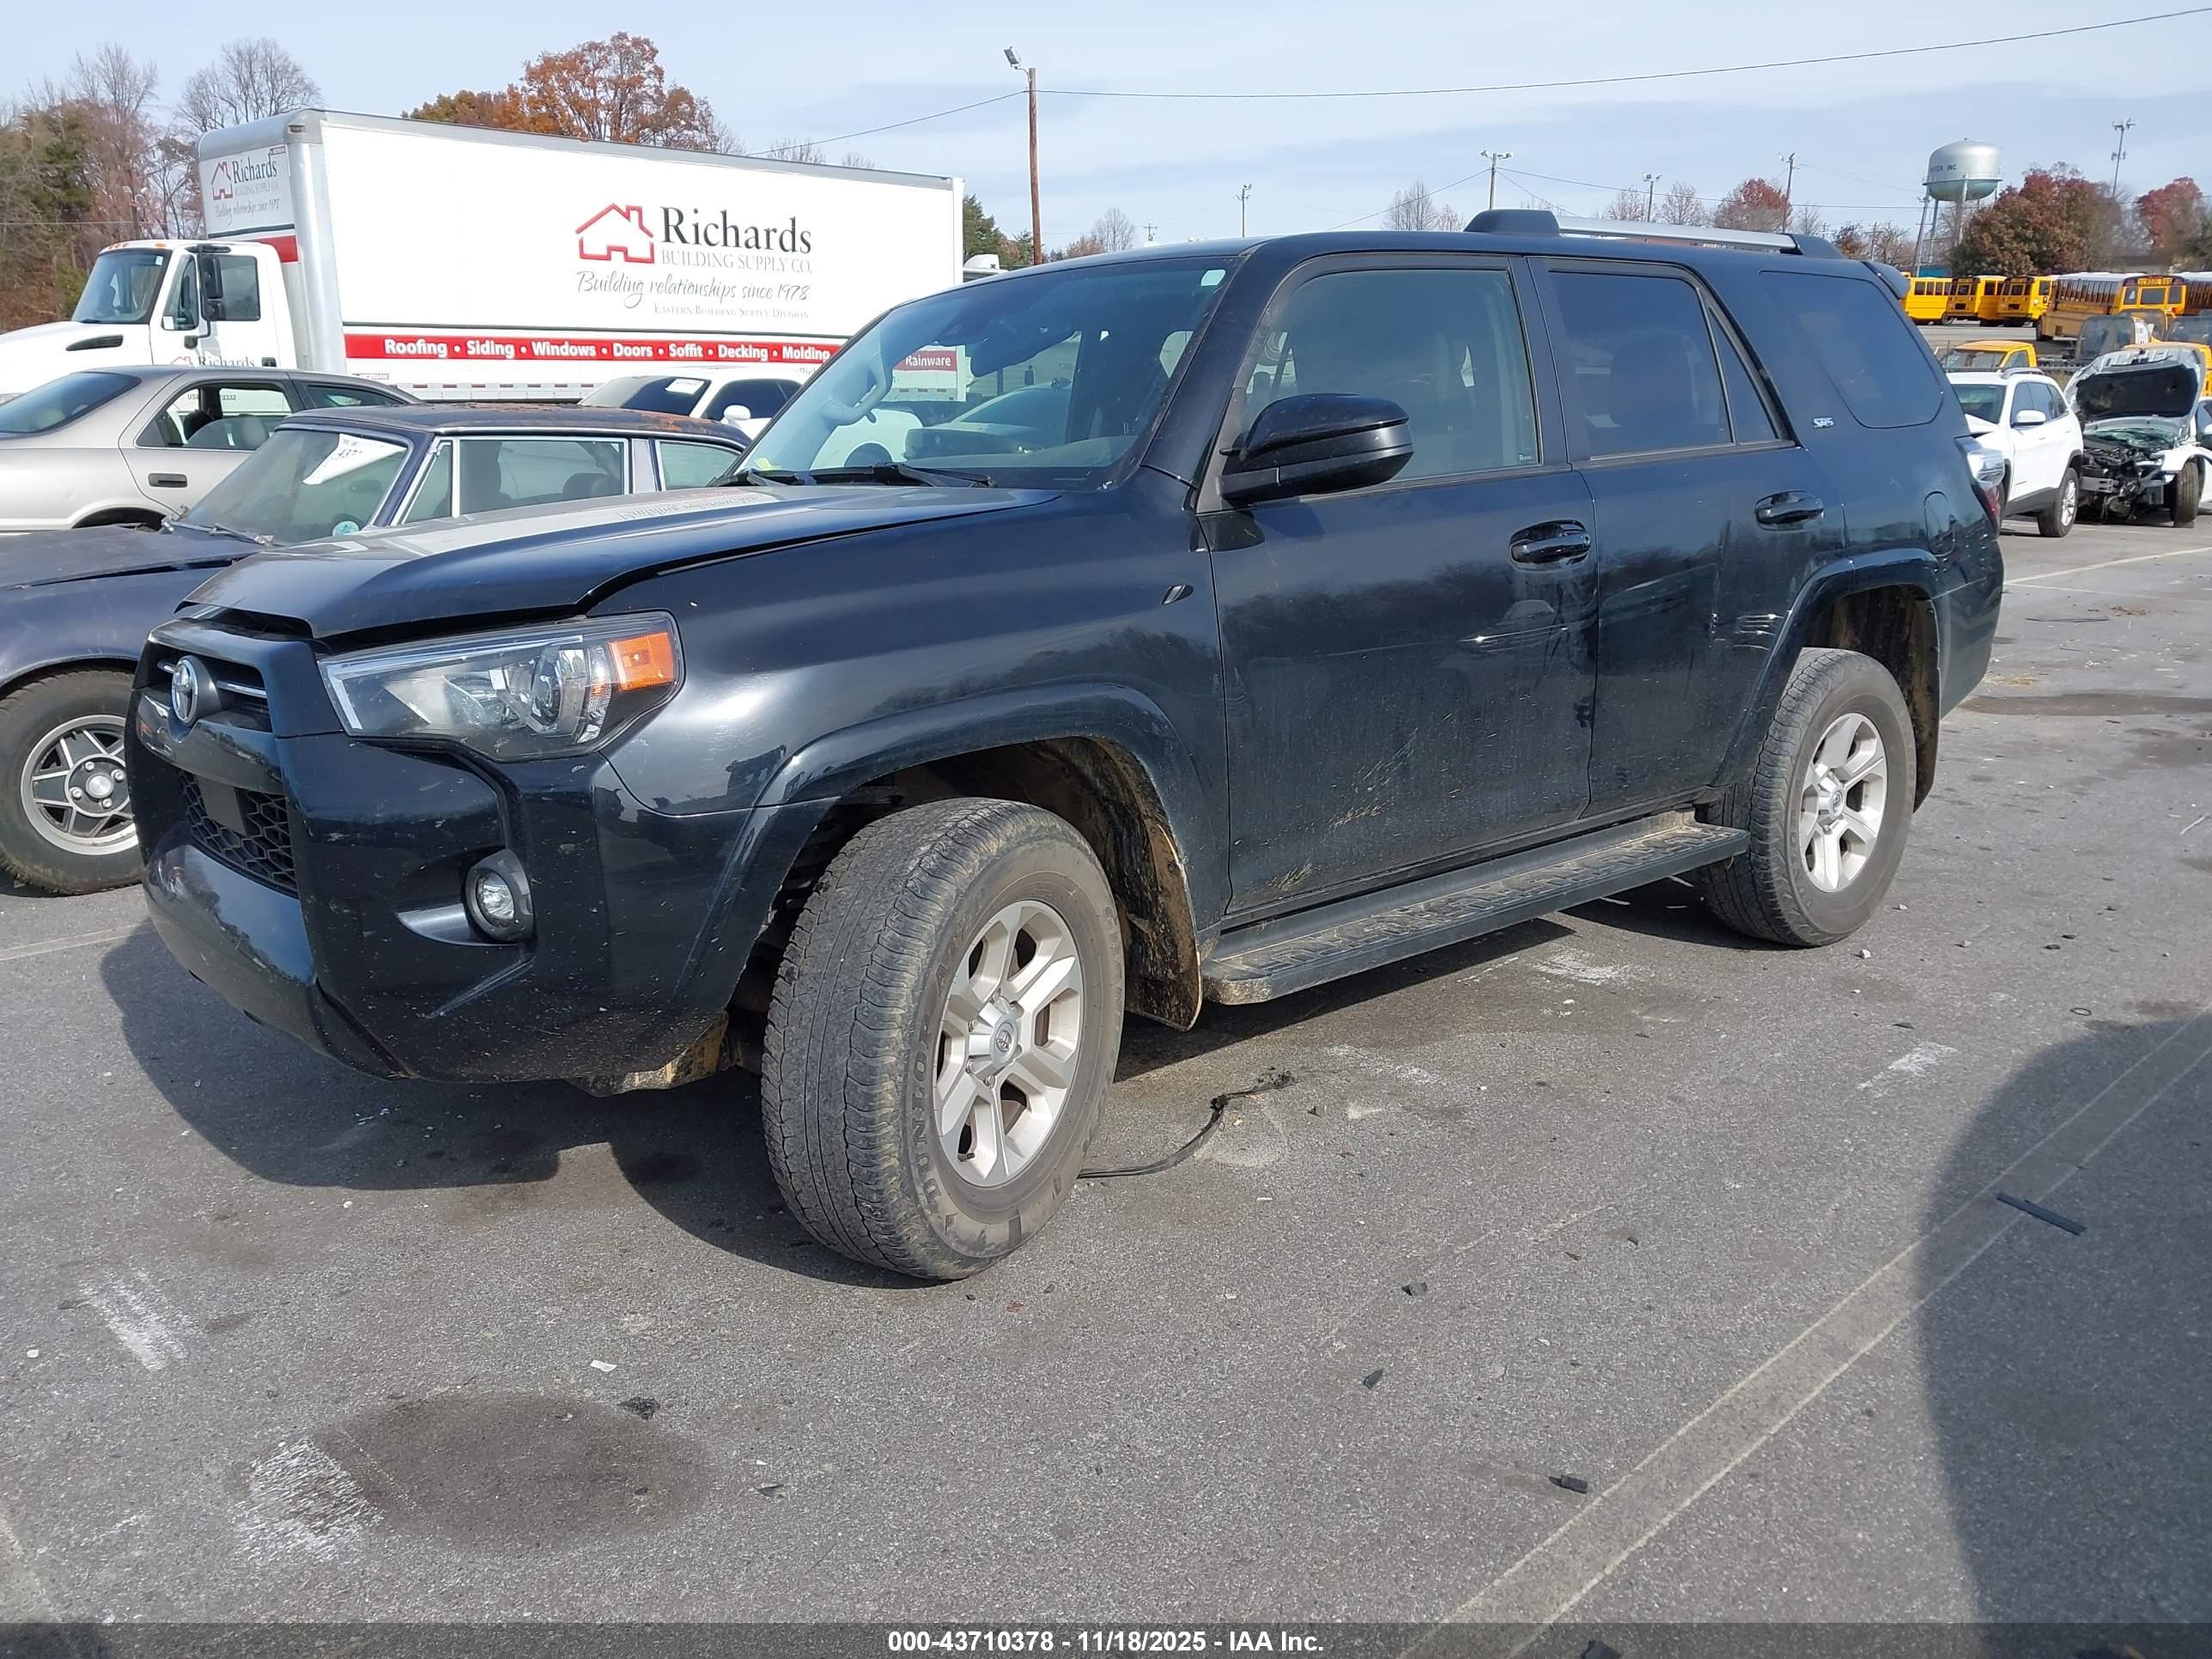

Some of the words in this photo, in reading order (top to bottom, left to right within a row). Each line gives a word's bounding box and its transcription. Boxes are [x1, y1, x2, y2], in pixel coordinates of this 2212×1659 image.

[232, 155, 277, 184] Richards
[659, 206, 811, 254] Richards
[661, 249, 733, 270] BUILDING
[738, 254, 787, 272] SUPPLY
[576, 270, 644, 309] Building
[650, 273, 736, 304] relationships
[742, 283, 774, 300] since
[777, 284, 811, 301] 1978
[198, 356, 255, 367] Richards
[384, 338, 448, 358] Roofing
[467, 340, 515, 359] Siding
[531, 341, 597, 357] Windows
[612, 343, 653, 357] Doors
[668, 343, 703, 358] Soffit
[718, 344, 769, 362] Decking
[782, 345, 831, 363] Molding
[905, 355, 951, 367] Rainware
[912, 1024, 941, 1203] DUNLOP
